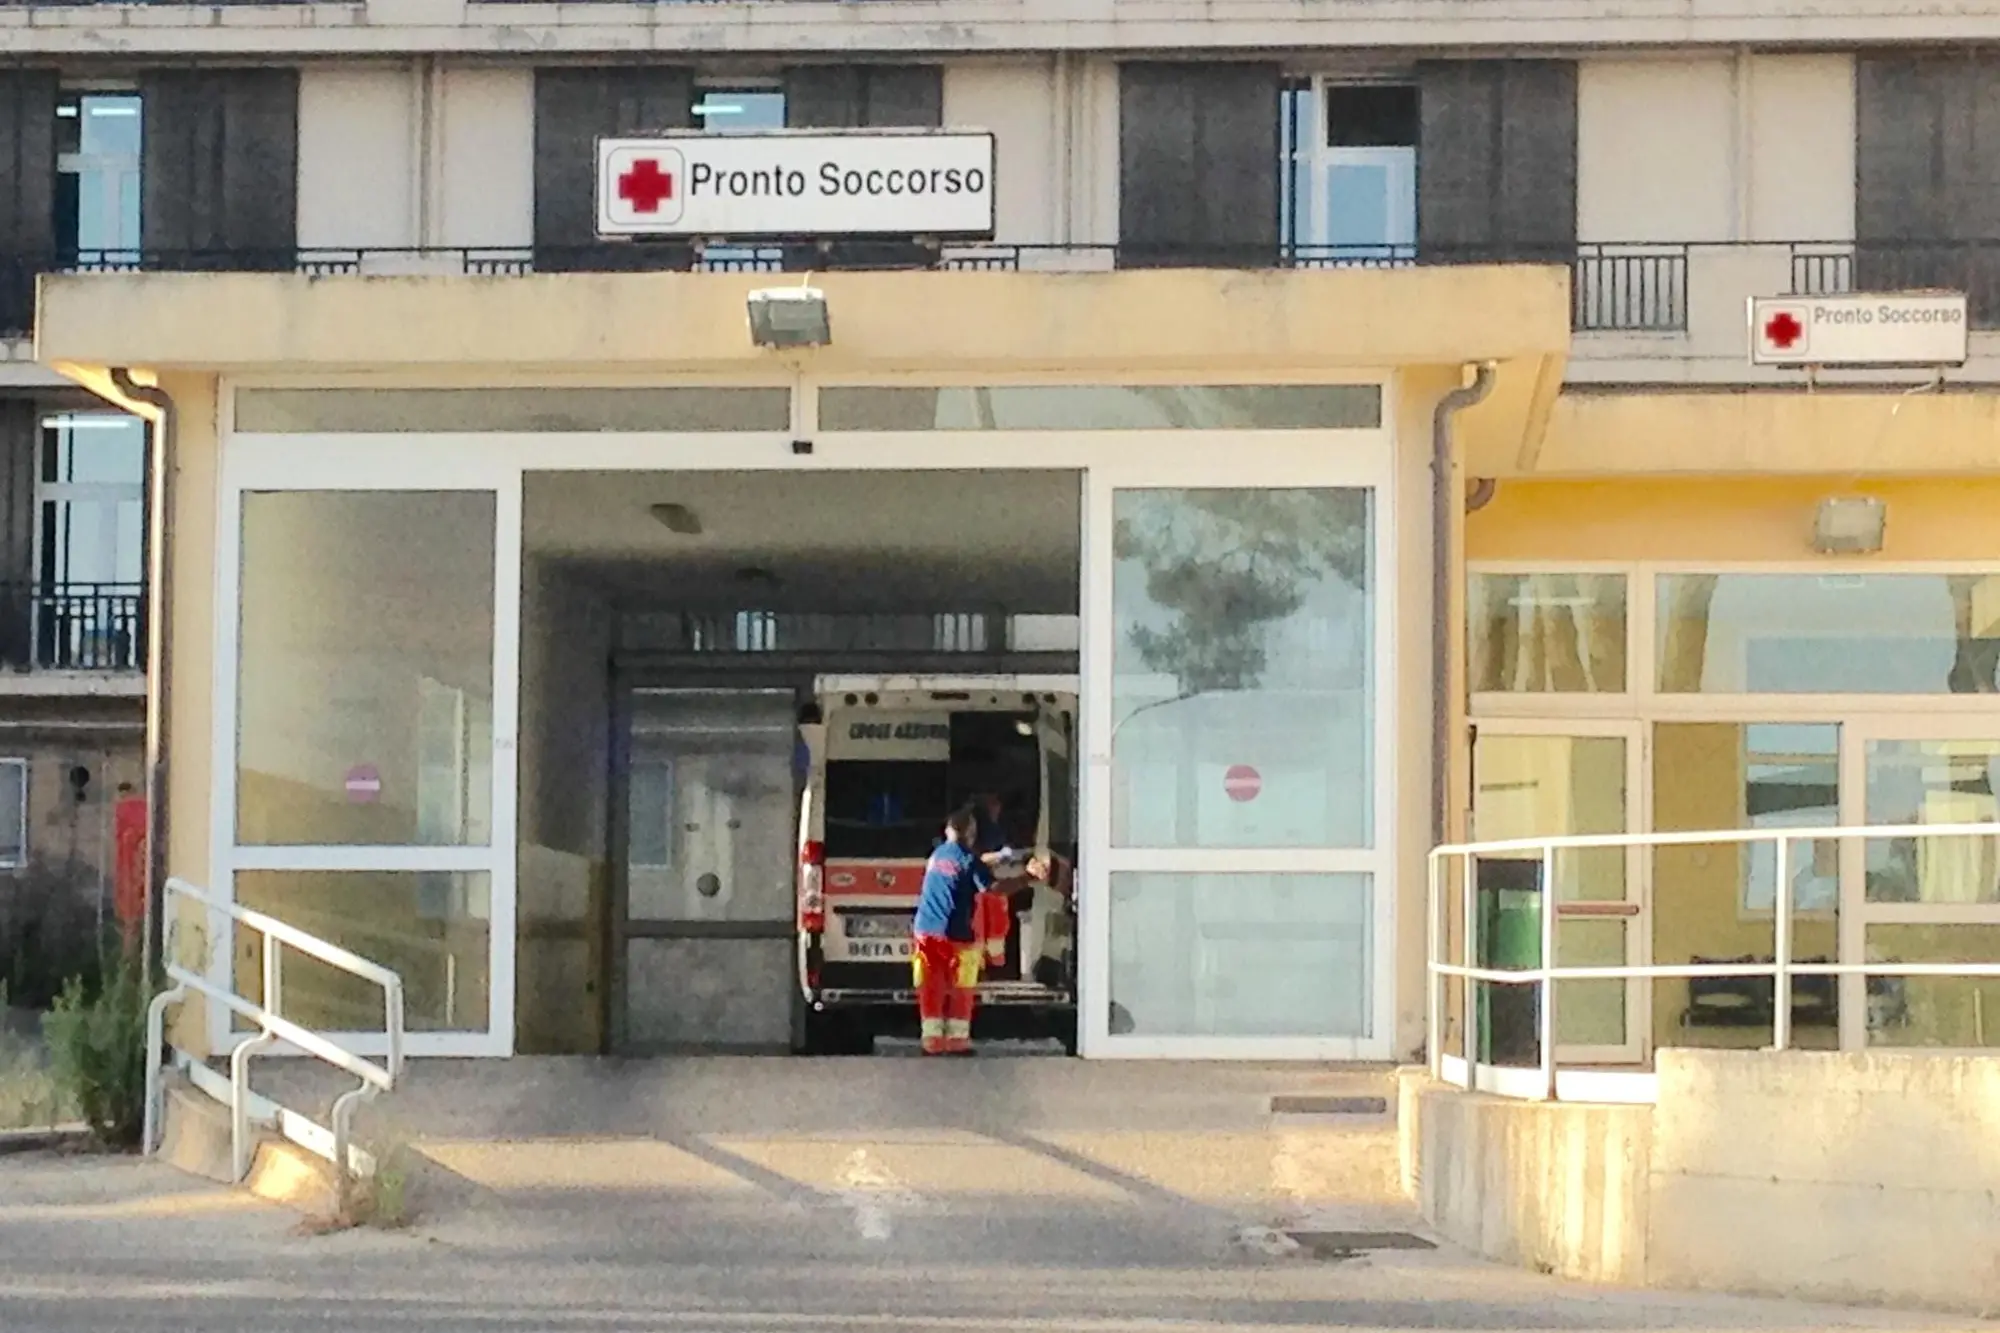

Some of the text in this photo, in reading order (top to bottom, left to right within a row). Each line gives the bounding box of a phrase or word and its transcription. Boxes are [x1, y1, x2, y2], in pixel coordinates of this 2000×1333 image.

[691, 162, 985, 196] Pronto Soccorso
[1813, 305, 1963, 324] Pronto Soccorso
